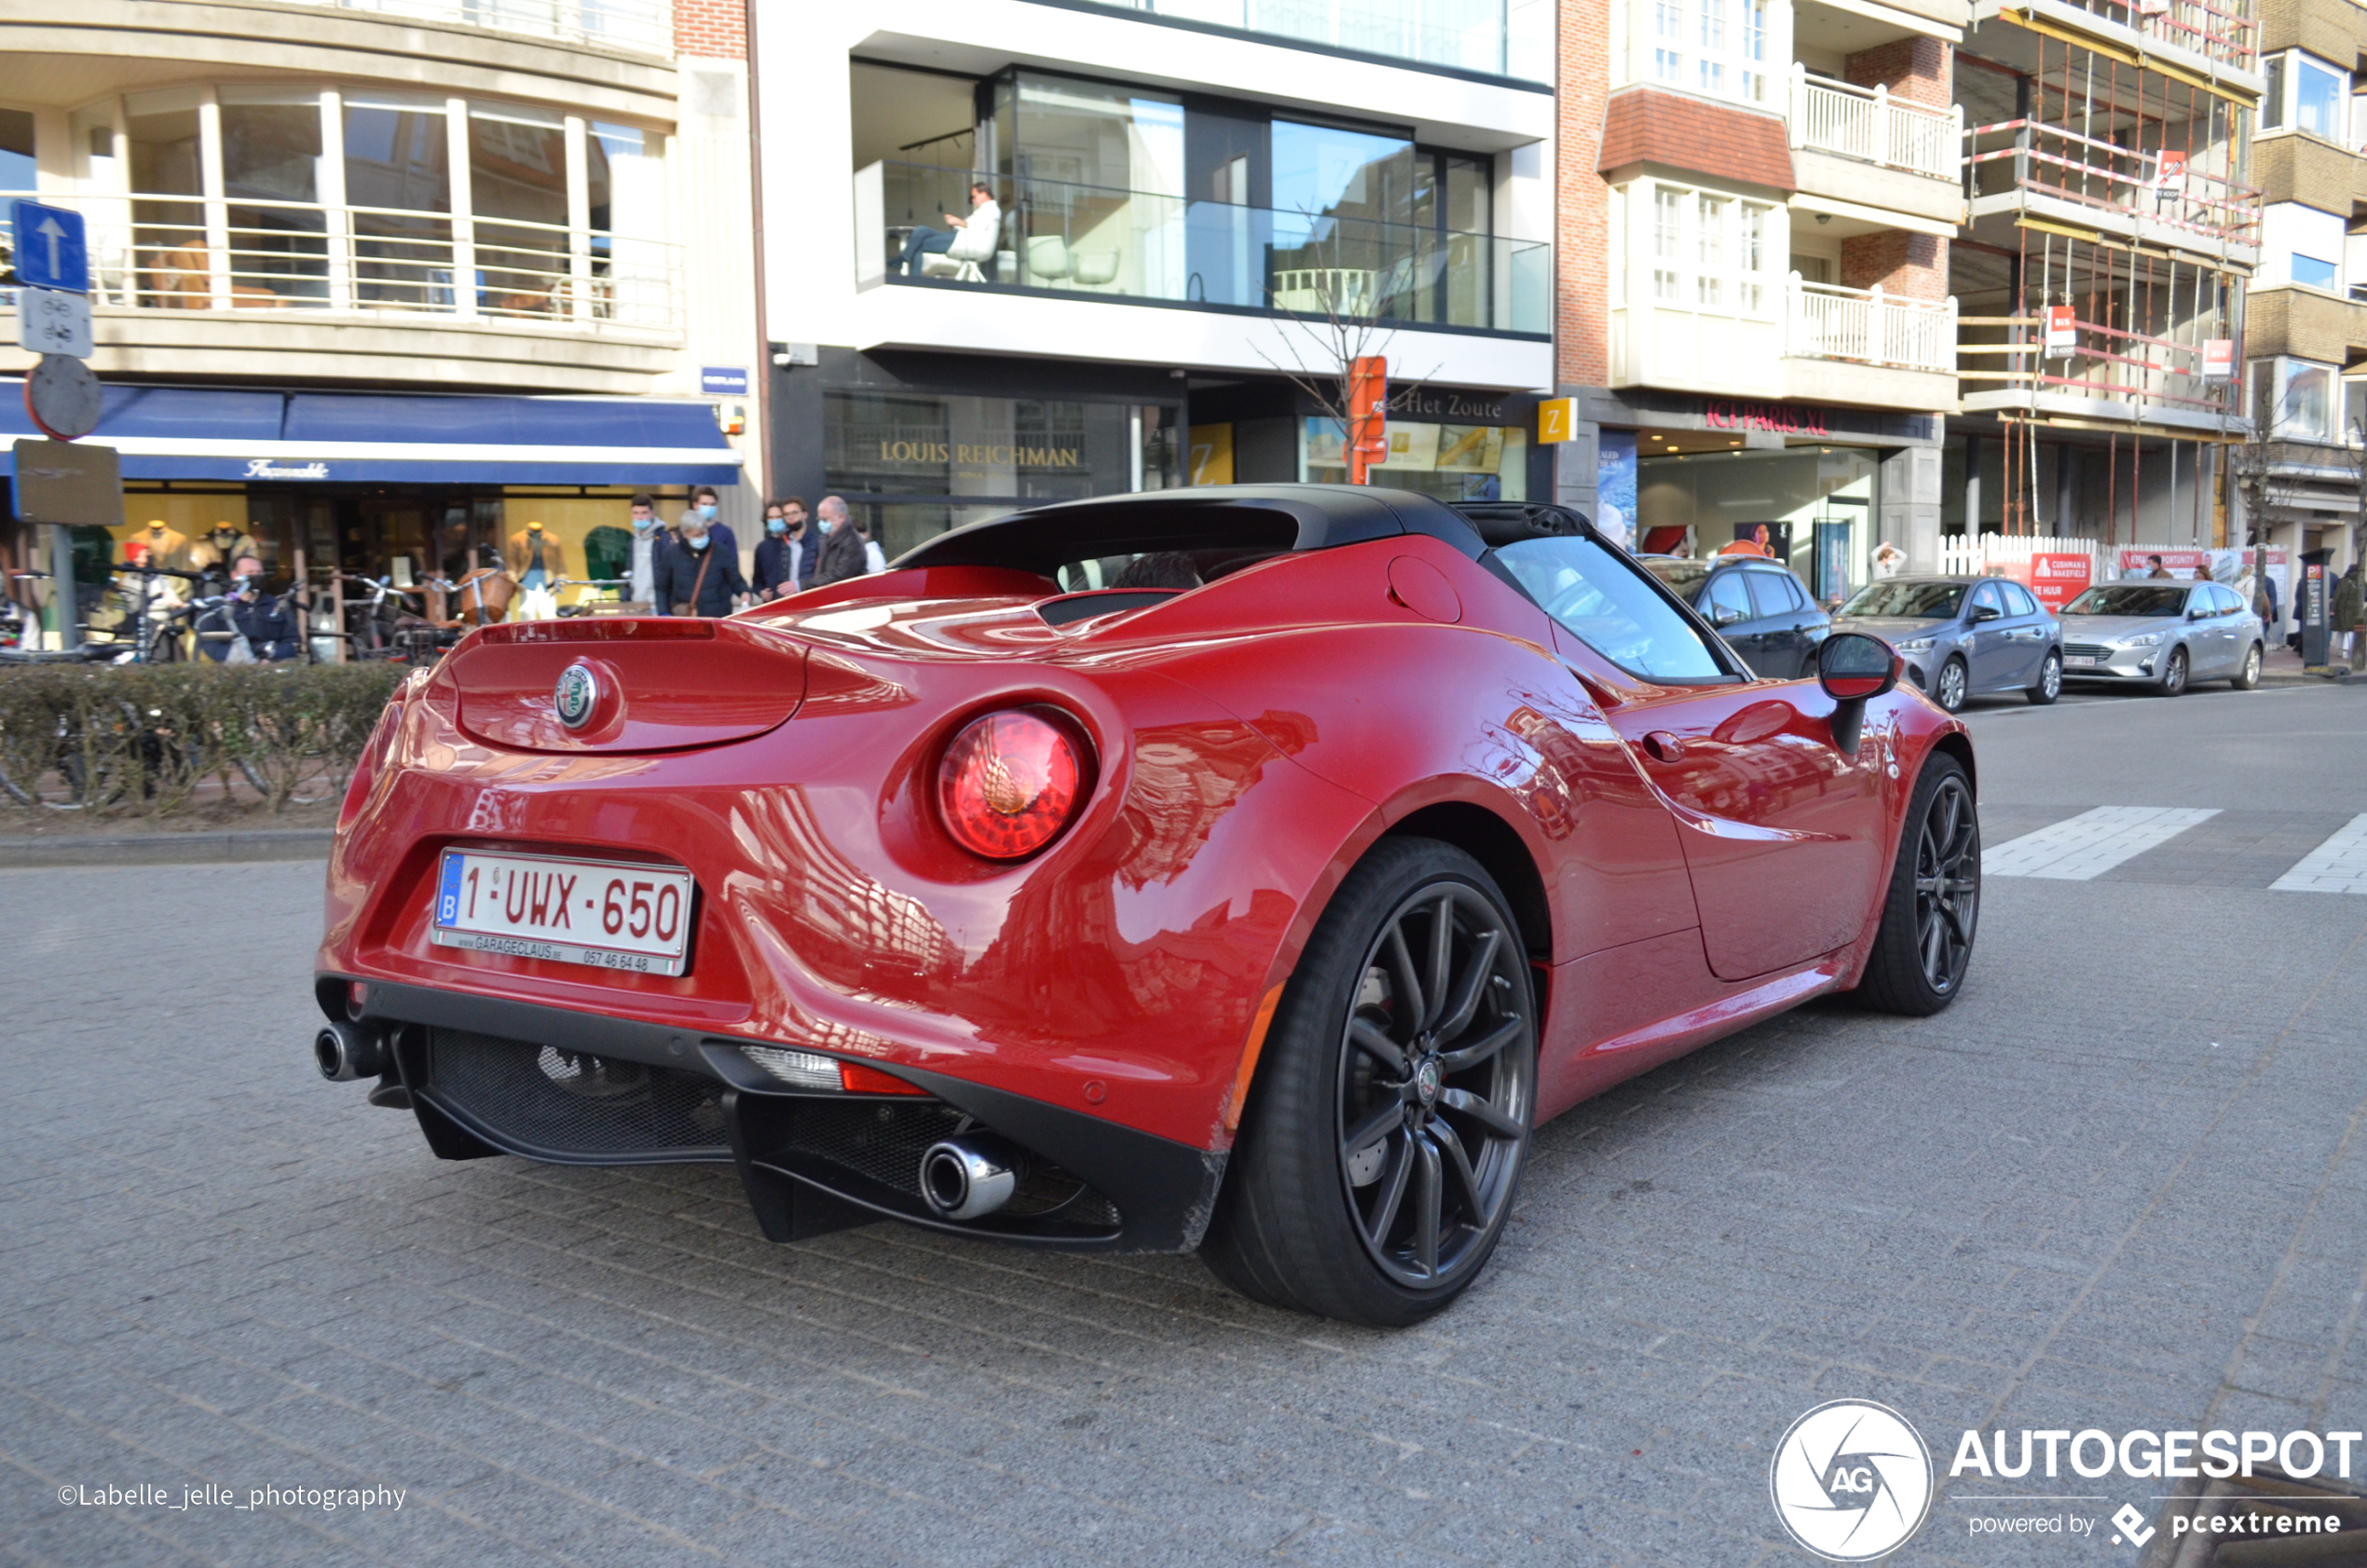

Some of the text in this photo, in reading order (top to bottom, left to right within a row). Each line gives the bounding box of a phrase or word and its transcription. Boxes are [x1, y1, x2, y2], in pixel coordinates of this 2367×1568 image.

[1406, 391, 1441, 414] Het
[1448, 394, 1501, 417] Zoute
[1548, 409, 1560, 434] Z
[1706, 401, 1828, 436] ICI PARIS XL
[881, 441, 1077, 467] LOUIS REICHMAN
[1192, 443, 1215, 486] Z
[2052, 561, 2081, 569] CUSHMAN
[2161, 554, 2195, 565] PORTUNITY
[2052, 569, 2087, 579] WAKEFIELD
[2033, 585, 2062, 595] TE HUUR
[442, 894, 456, 920] B
[583, 950, 602, 965] 057
[605, 953, 617, 967] 46
[620, 955, 633, 969] 64
[636, 957, 649, 971] 48
